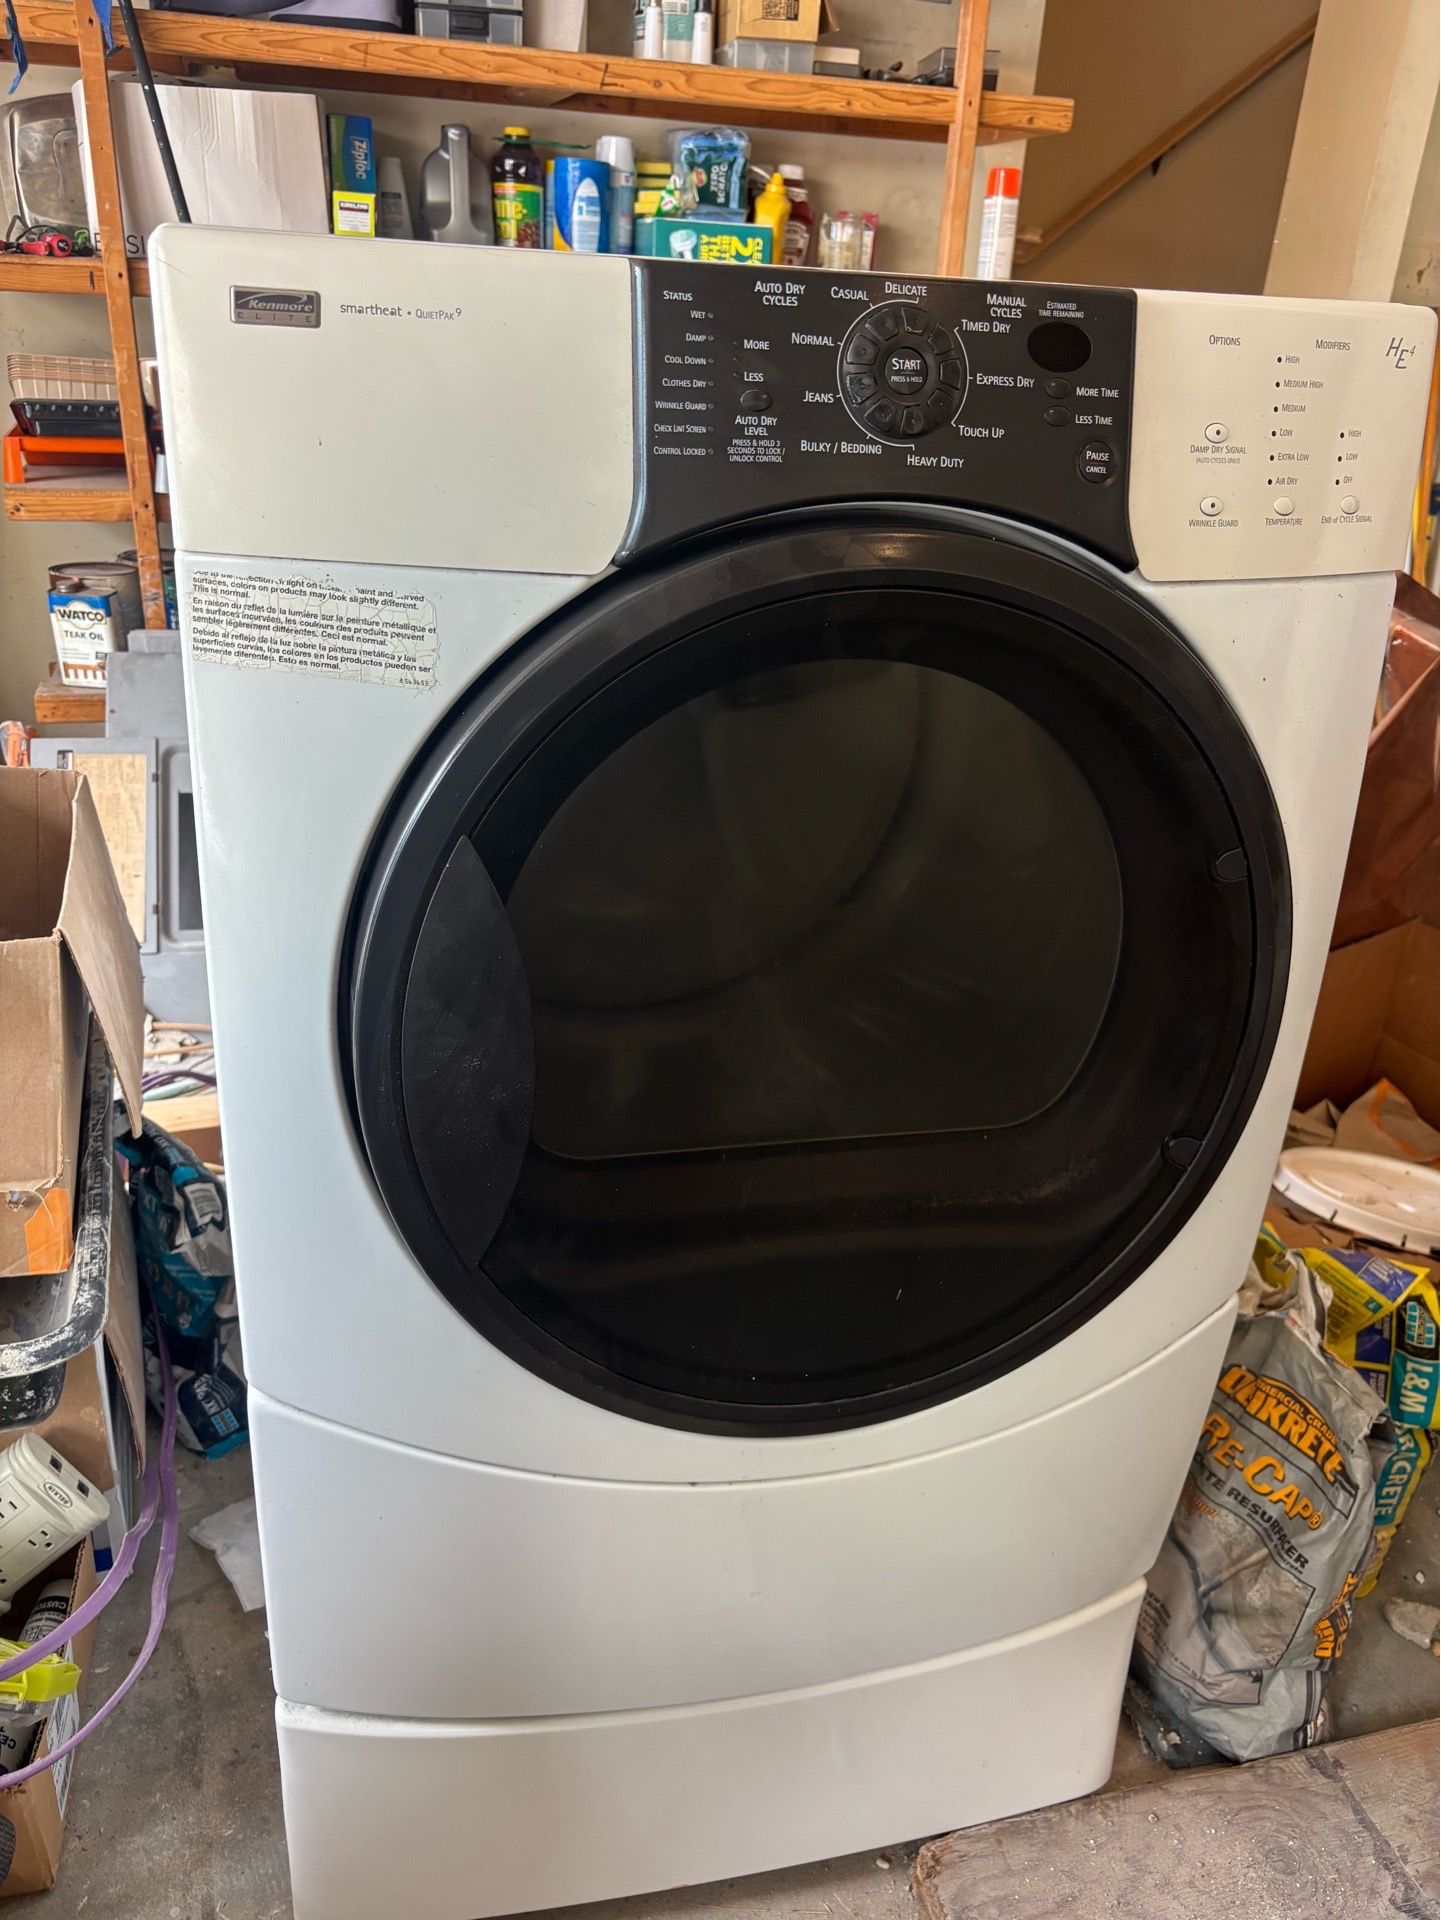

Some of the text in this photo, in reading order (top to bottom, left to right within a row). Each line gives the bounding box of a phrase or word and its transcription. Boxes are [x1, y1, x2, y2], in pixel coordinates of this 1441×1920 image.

[351, 139, 369, 180] Ziploc
[755, 281, 806, 296] AUTO DRY
[831, 287, 870, 301] CASUAL
[885, 281, 928, 297] DELICATE
[663, 291, 693, 302] STATUS
[763, 295, 798, 307] CYCLES
[987, 293, 1027, 308] MANUAL
[248, 298, 313, 313] Kenmore
[340, 303, 403, 317] smartheat
[1047, 301, 1077, 311] ESTIMATED
[238, 311, 312, 324] ELITE
[691, 310, 706, 319] WET
[990, 308, 1022, 319] CYCLES
[1039, 309, 1084, 319] TIME REMAINING
[961, 319, 1012, 334] TIMED DRY
[686, 333, 707, 342] DAMP
[792, 332, 835, 347] NORMAL
[1208, 334, 1241, 347] OPTIONS
[744, 340, 770, 350] MORE
[1315, 339, 1351, 351] MODIFIERS
[664, 355, 707, 365] COOL DOWN
[892, 358, 922, 371] START
[1285, 355, 1300, 364] HIGH
[744, 372, 764, 382] LESS
[891, 375, 906, 383] PRESS
[976, 374, 1036, 388] EXPRESS DRY
[662, 378, 707, 389] CLOTHES DRY
[1283, 379, 1324, 389] MEDIUM HIGH
[803, 390, 834, 404] JEANS
[1077, 387, 1120, 398] MORE TIME
[655, 401, 707, 411] WRINKLE GUARD
[1281, 403, 1306, 413] MEDIUM
[735, 415, 778, 427] AUTO DRY
[1075, 415, 1113, 426] LESS TIME
[654, 424, 707, 434] CHECK LINT SCREEN
[745, 426, 769, 436] LEVEL
[959, 425, 1005, 439] TOUCH UP
[1279, 428, 1294, 437] LOW
[1348, 429, 1362, 438] HIGH
[732, 439, 752, 447] PRESS
[800, 440, 883, 455] BULKY BEDDING
[654, 447, 707, 456] CONTROL LOCKED
[727, 447, 757, 455] SECONDS
[1190, 444, 1247, 455] DAMP DRY SIGNAL
[730, 455, 755, 463] UNLOCK
[907, 454, 965, 468] HEAVY DUTY
[1086, 451, 1110, 462] PAUSE
[1278, 452, 1310, 461] EXTRA LOW
[1345, 452, 1359, 461] LOW
[1086, 466, 1107, 474] CANCEL
[1275, 476, 1299, 486] AIR DRY
[1343, 476, 1354, 485] OFF
[1189, 519, 1239, 528] WRINKLE GUARD
[1265, 517, 1303, 527] TEMPERATURE
[193, 584, 209, 593] This
[231, 581, 257, 591] colors
[270, 587, 308, 597] products
[310, 592, 327, 602] may
[329, 592, 347, 602] look
[349, 595, 380, 607] slightly
[377, 590, 394, 598] and
[193, 597, 203, 605] En
[204, 599, 230, 609] raison
[58, 609, 104, 622] WATCO
[285, 617, 297, 626] les
[353, 626, 389, 638] produits
[64, 630, 105, 641] TEAK OIL
[193, 627, 220, 638] Debido
[231, 633, 256, 644] reflejo
[280, 638, 292, 647] luz
[321, 631, 341, 640] Ceci
[341, 633, 355, 641] est
[356, 636, 388, 647] normal.
[278, 655, 297, 665] Esto
[310, 660, 341, 671] normal.
[326, 653, 339, 662] los
[340, 656, 383, 668] productos
[1400, 1361, 1434, 1413] L&M
[1226, 1487, 1310, 1570] RESURFACER
